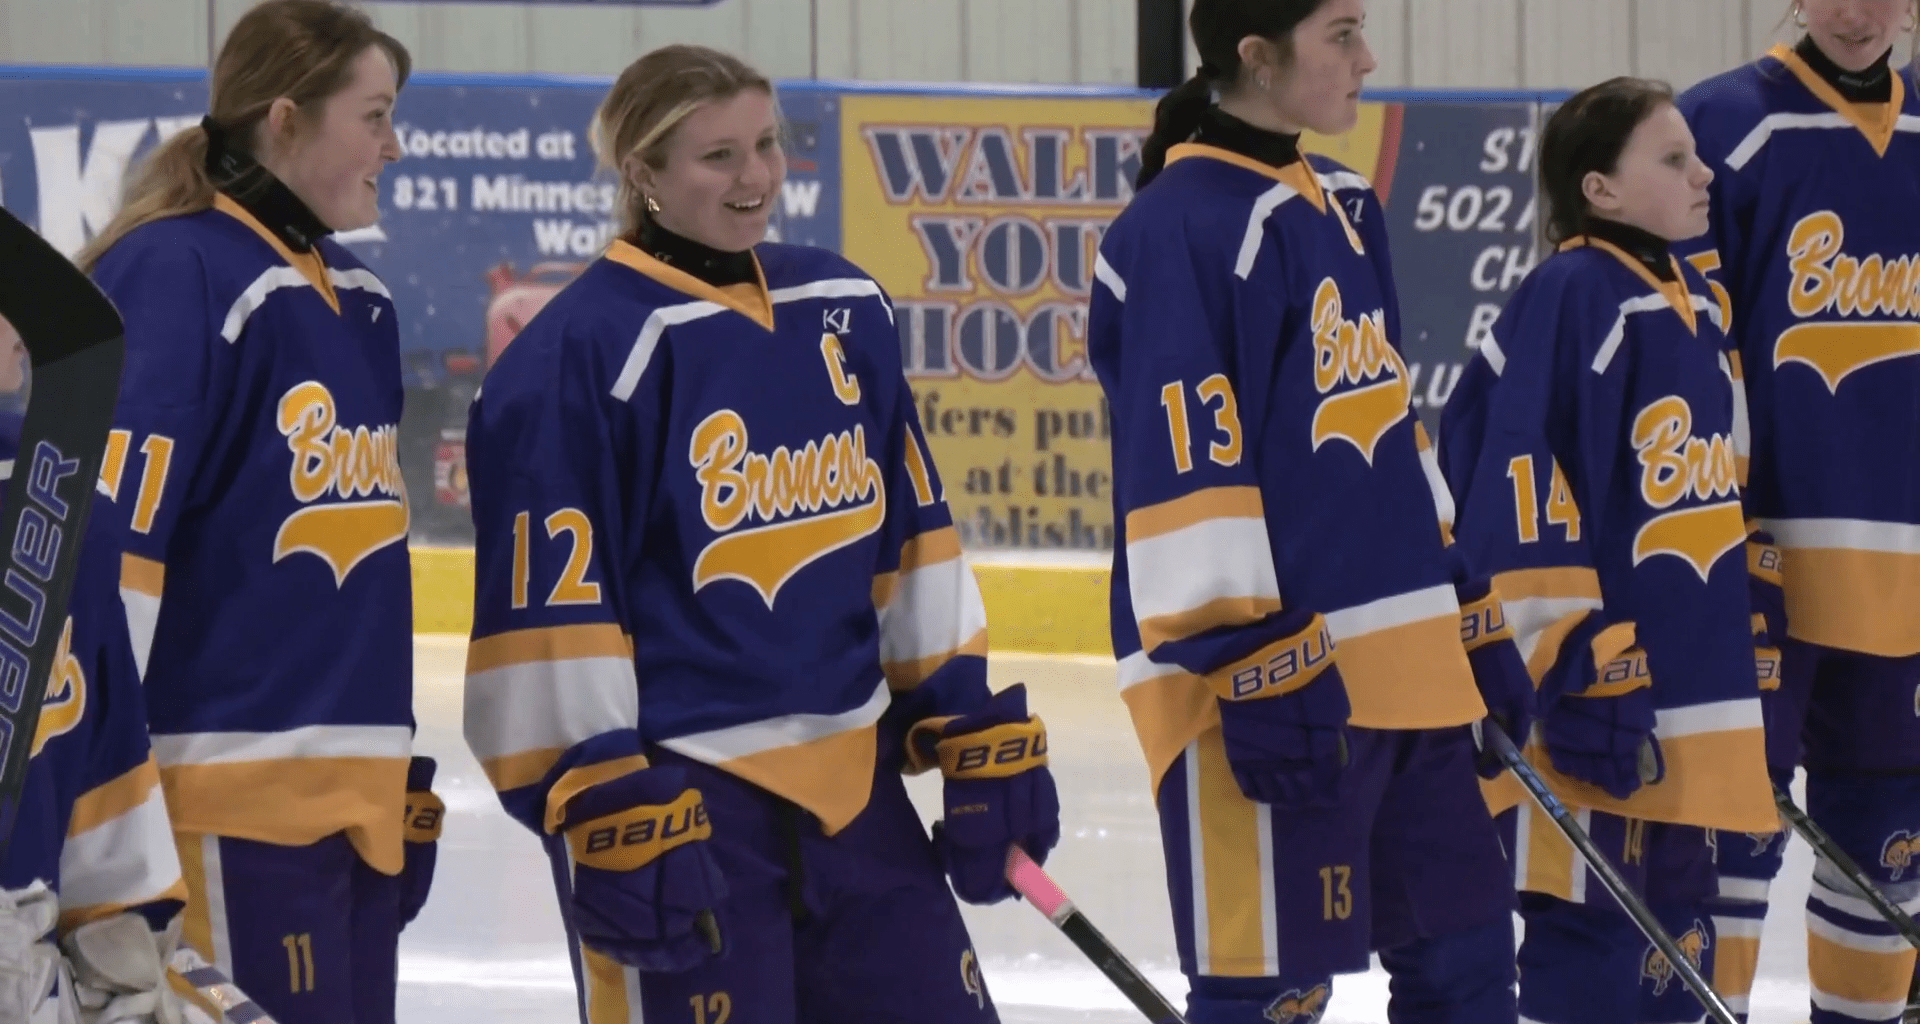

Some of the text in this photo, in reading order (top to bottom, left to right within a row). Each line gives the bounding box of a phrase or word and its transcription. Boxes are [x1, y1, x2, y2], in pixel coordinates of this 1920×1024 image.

[536, 130, 575, 160] at
[393, 175, 457, 211] 821
[823, 308, 851, 334] K1
[820, 333, 861, 405] C
[912, 391, 1016, 437] fers
[1161, 373, 1243, 475] 13
[689, 409, 886, 532] Broncos
[965, 457, 1012, 495] at
[1506, 453, 1581, 545] 14
[511, 508, 601, 610] 12
[1319, 866, 1352, 920] 13
[282, 932, 315, 994] 11
